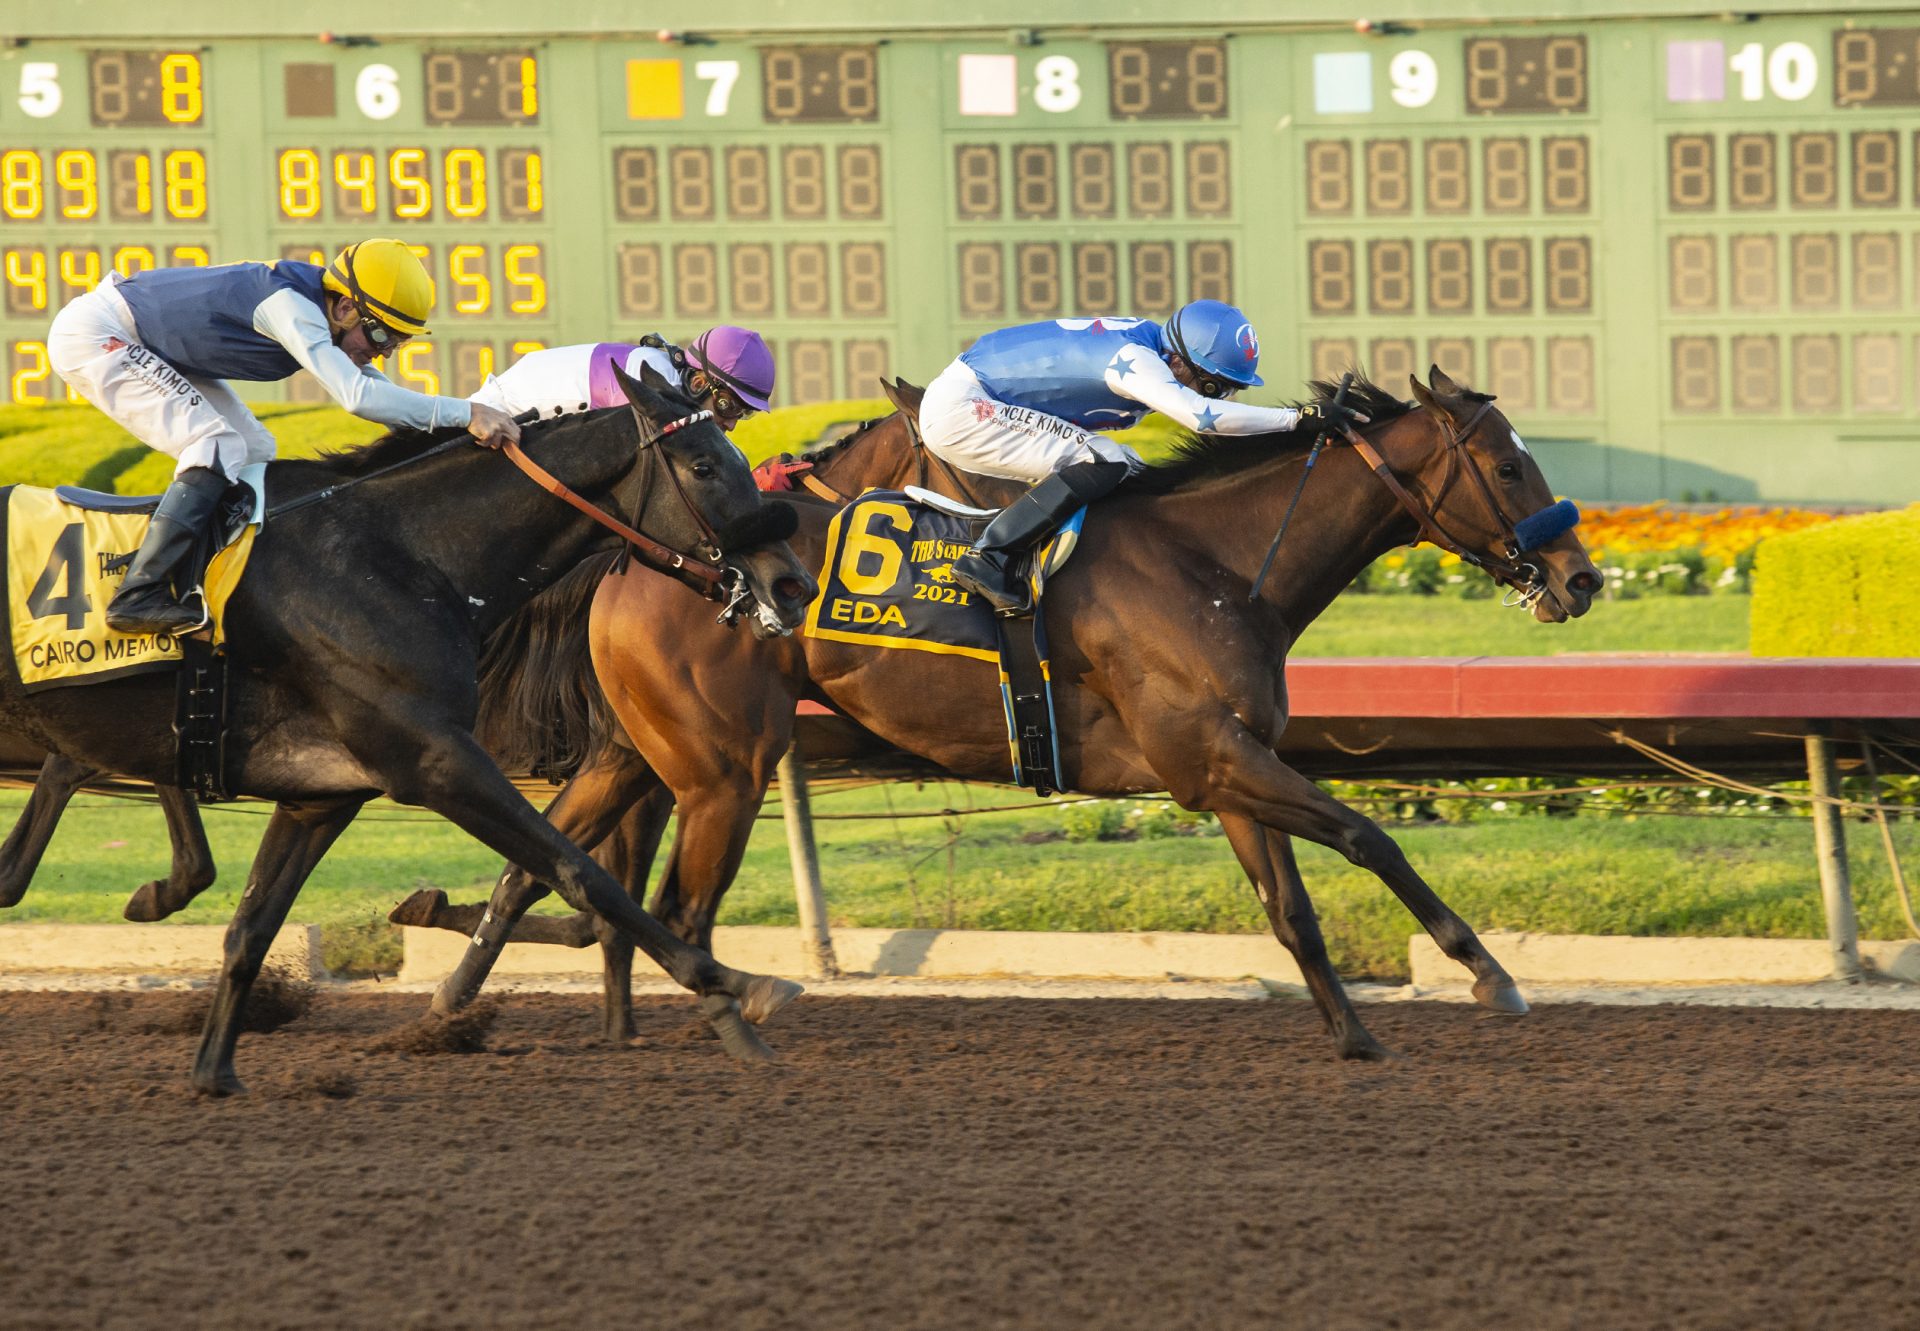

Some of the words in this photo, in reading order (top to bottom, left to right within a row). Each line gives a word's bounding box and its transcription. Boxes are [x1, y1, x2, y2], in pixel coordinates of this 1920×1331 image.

[18, 62, 63, 118] 5
[160, 54, 203, 123] 8
[355, 63, 401, 120] 6
[520, 56, 538, 117] 1
[695, 60, 740, 116] 7
[1033, 55, 1082, 113] 8
[1389, 50, 1439, 108] 9
[1730, 42, 1818, 101] 10
[152, 363, 203, 407] KIMO'S
[1000, 405, 1035, 425] NCLE
[1036, 415, 1087, 445] KIMO'S
[838, 500, 914, 596] 6
[910, 539, 935, 563] THE
[26, 522, 93, 631] 4
[912, 583, 970, 606] 2021
[830, 598, 907, 629] EDA
[31, 639, 96, 668] CAIRO
